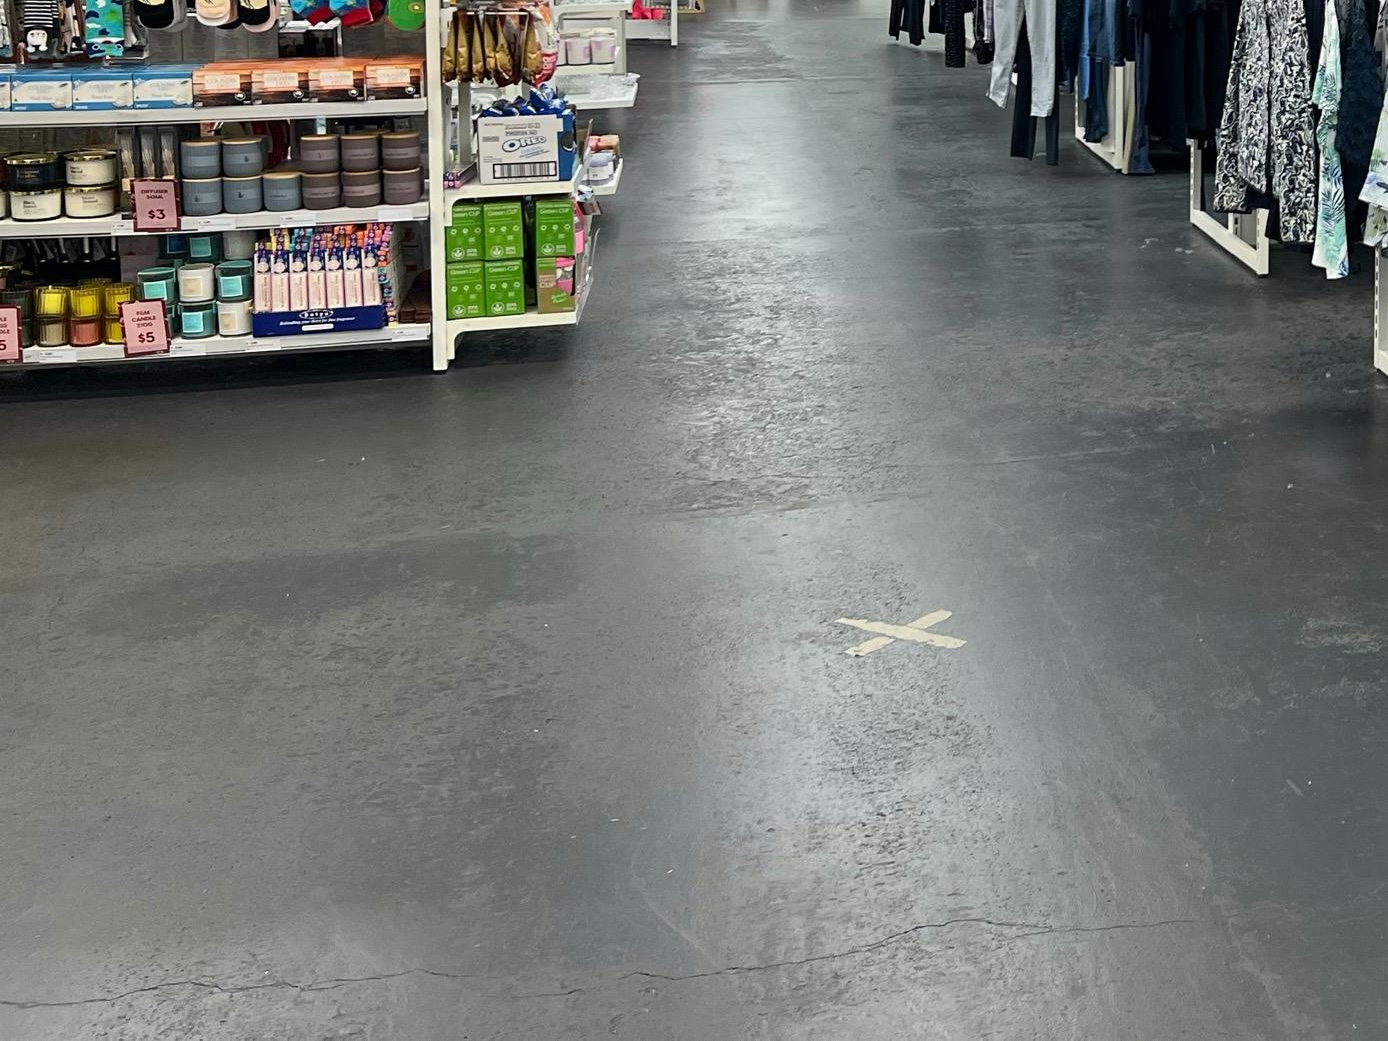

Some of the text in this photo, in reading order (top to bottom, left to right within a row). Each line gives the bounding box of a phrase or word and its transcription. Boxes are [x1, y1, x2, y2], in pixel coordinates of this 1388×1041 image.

[502, 135, 547, 152] OREO
[147, 208, 166, 220] $3
[138, 331, 155, 343] $5
